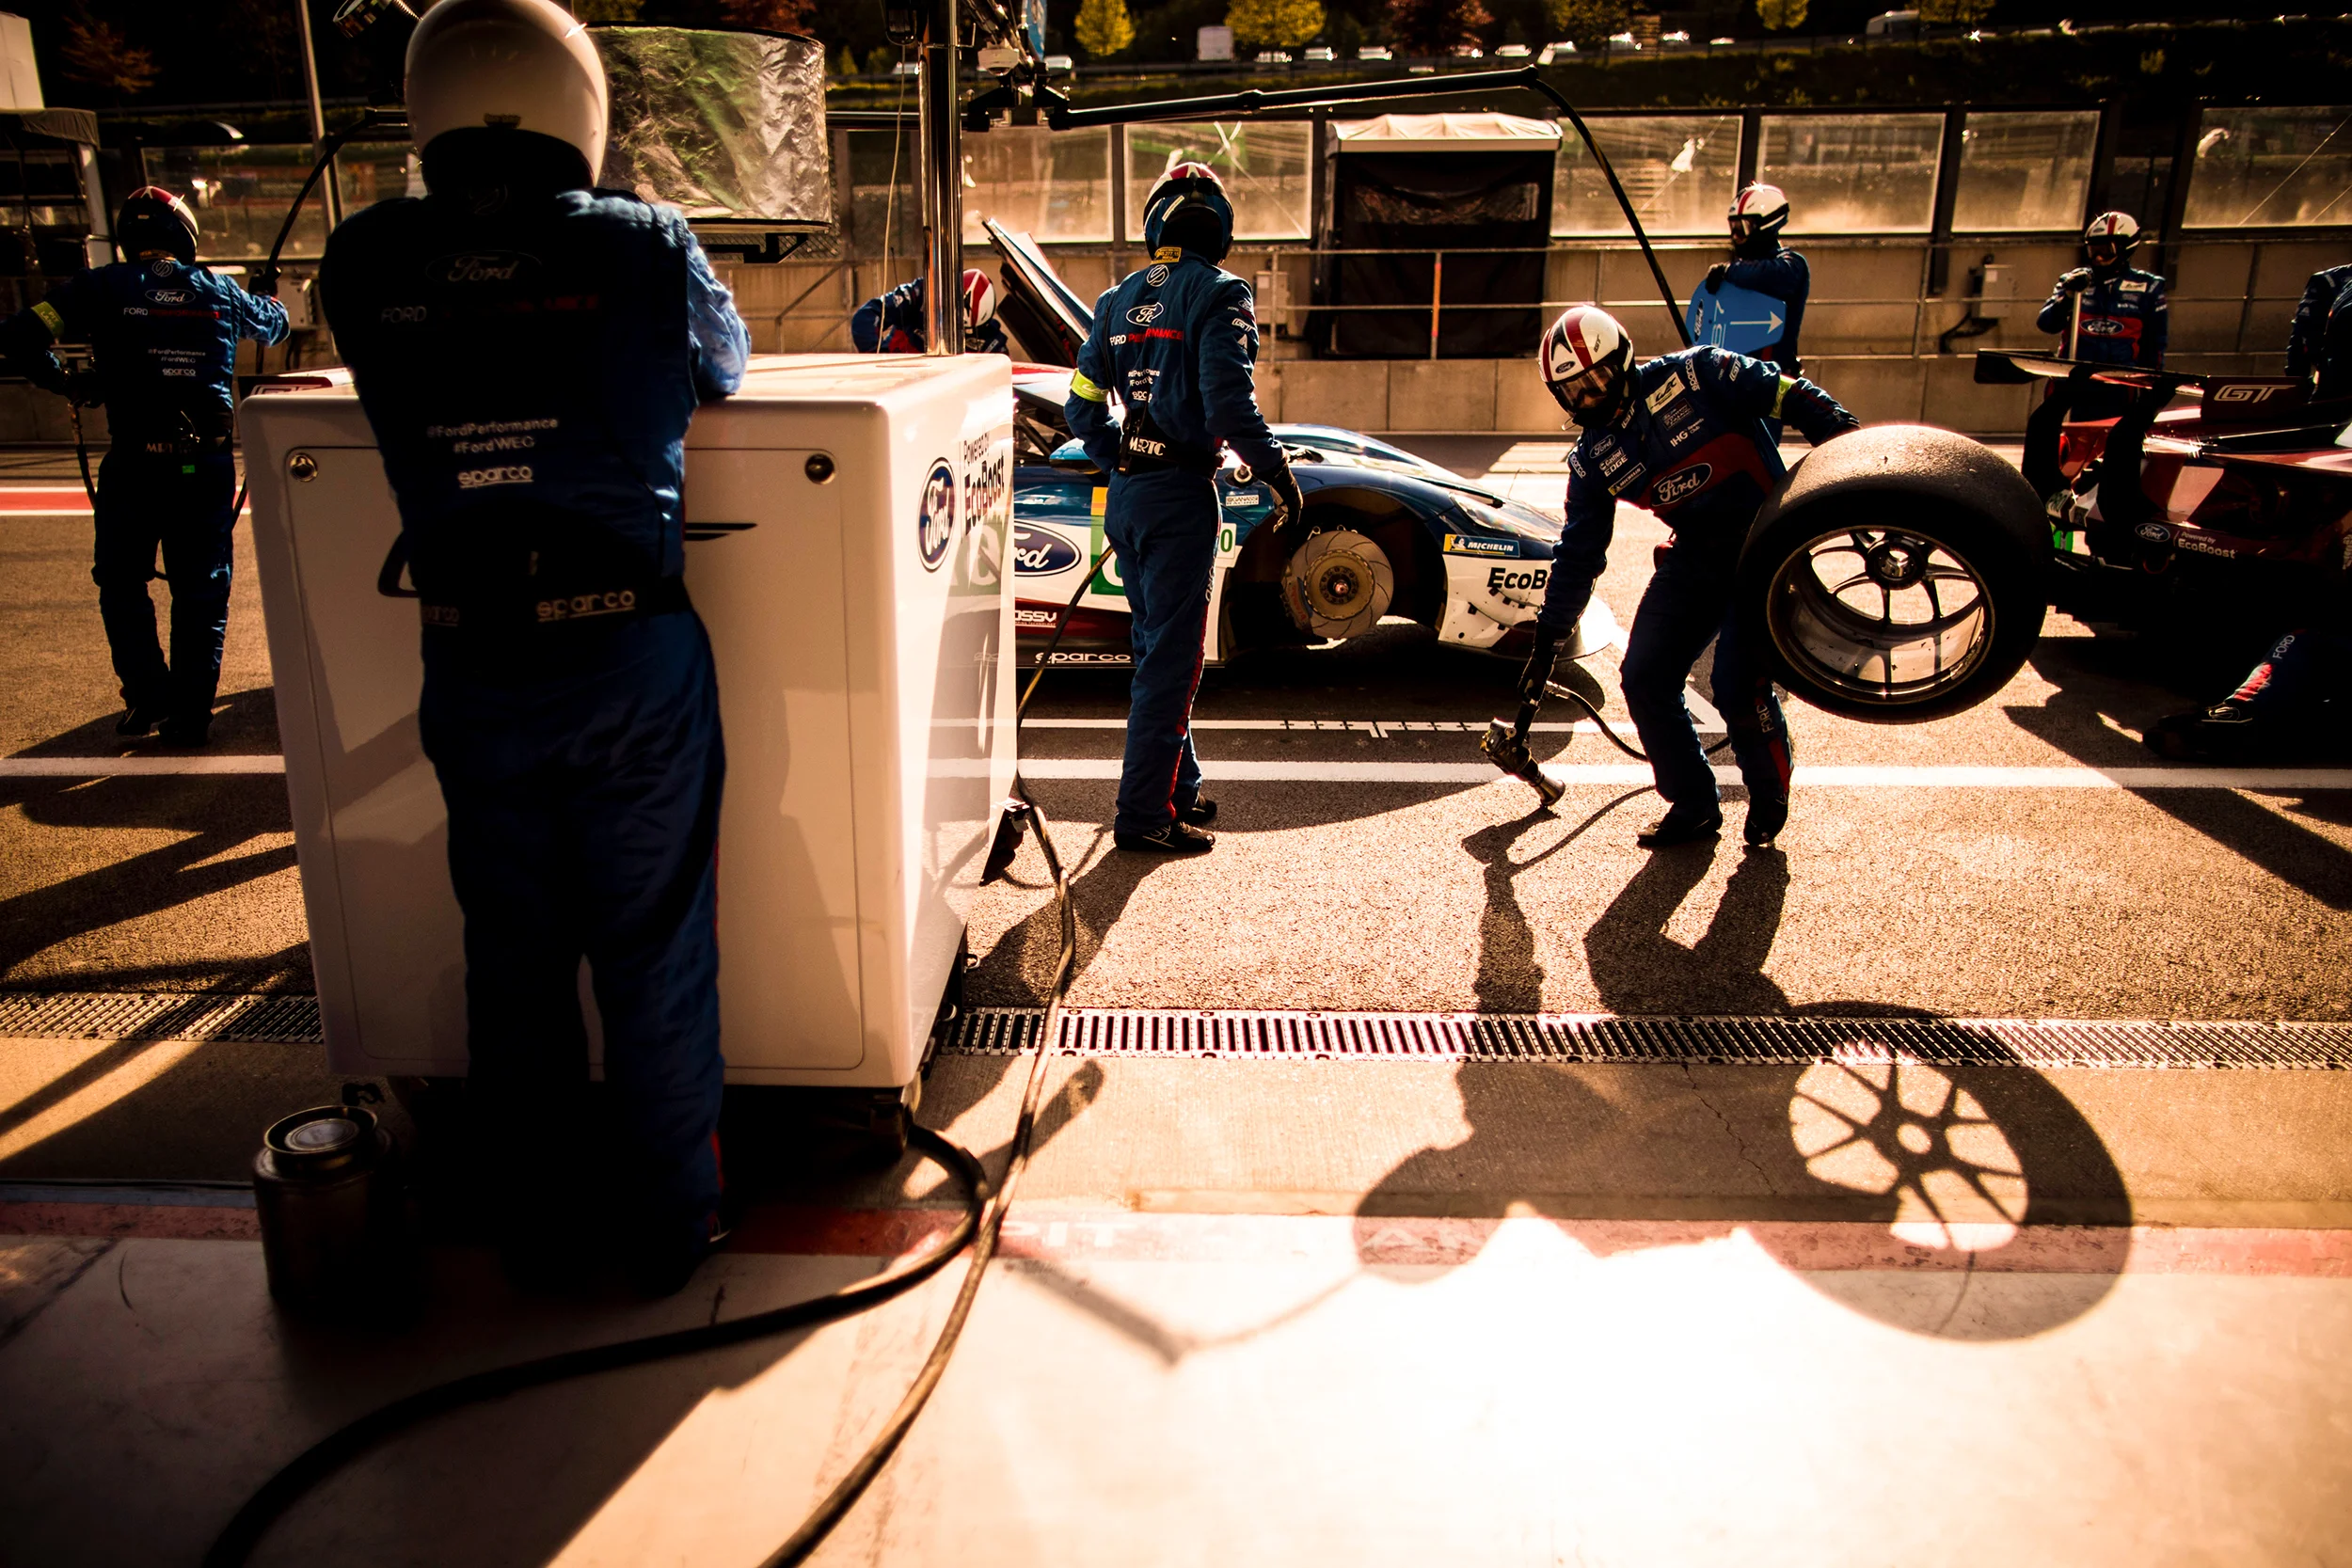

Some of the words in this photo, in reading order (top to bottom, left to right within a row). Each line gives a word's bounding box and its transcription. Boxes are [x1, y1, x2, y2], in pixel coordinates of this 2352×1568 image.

[448, 255, 519, 282] Ford
[154, 292, 186, 303] Ford
[123, 307, 149, 316] FORD
[380, 305, 427, 324] FORD
[2214, 385, 2298, 404] GT
[1669, 430, 1689, 448] IHG
[1604, 453, 1629, 477] EDGE
[457, 466, 534, 489] sparco
[1658, 472, 1701, 502] Ford
[964, 451, 1006, 537] EcoBoost
[925, 477, 950, 557] Ford
[1468, 541, 1515, 552] MICHELIN
[2178, 537, 2236, 560] EcoBoost
[1487, 567, 1548, 590] EcoB
[535, 590, 637, 623] sparco
[2272, 634, 2296, 659] FORD
